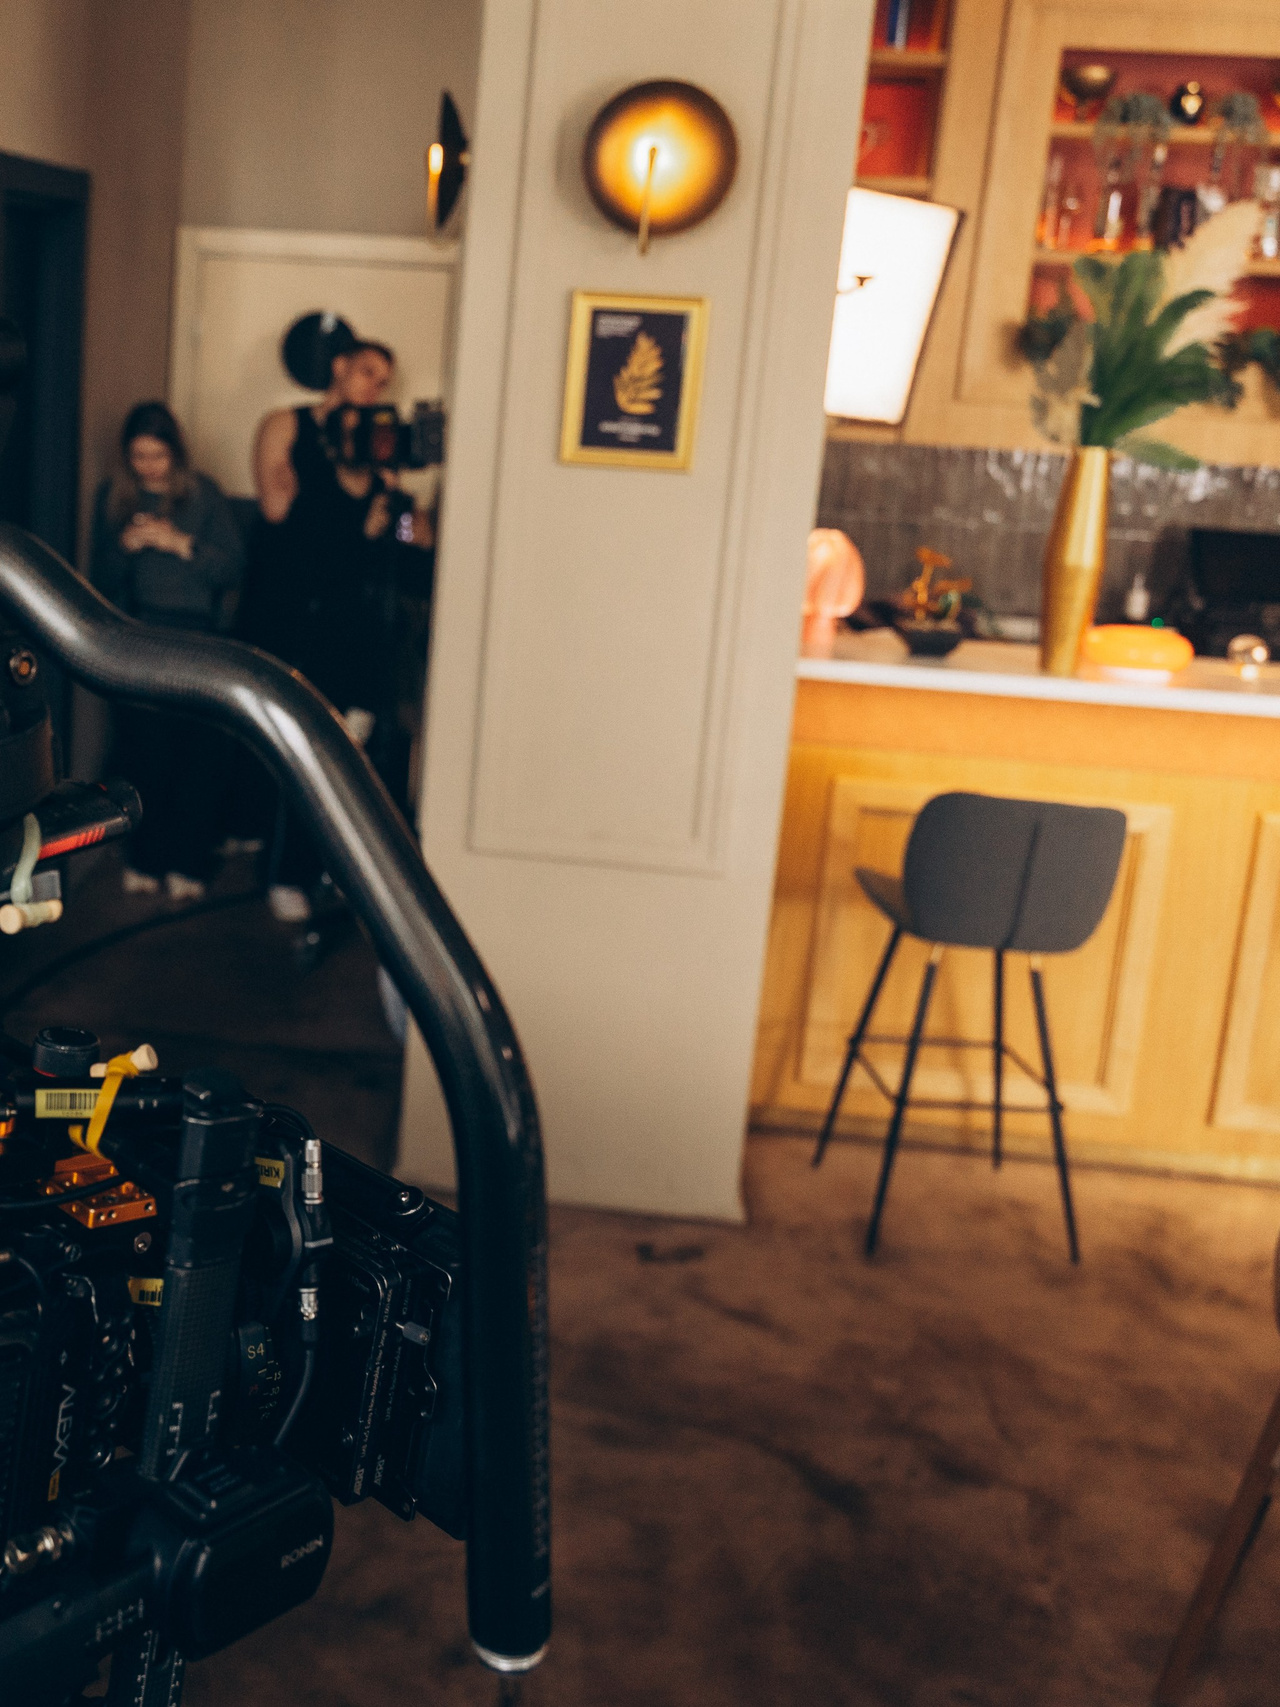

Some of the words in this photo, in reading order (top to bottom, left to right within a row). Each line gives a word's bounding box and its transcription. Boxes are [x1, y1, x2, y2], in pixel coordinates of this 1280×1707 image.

[247, 1342, 265, 1360] S4
[50, 1383, 76, 1476] ALEXA
[373, 1458, 386, 1487] ARRI
[281, 1534, 324, 1569] RONIN
